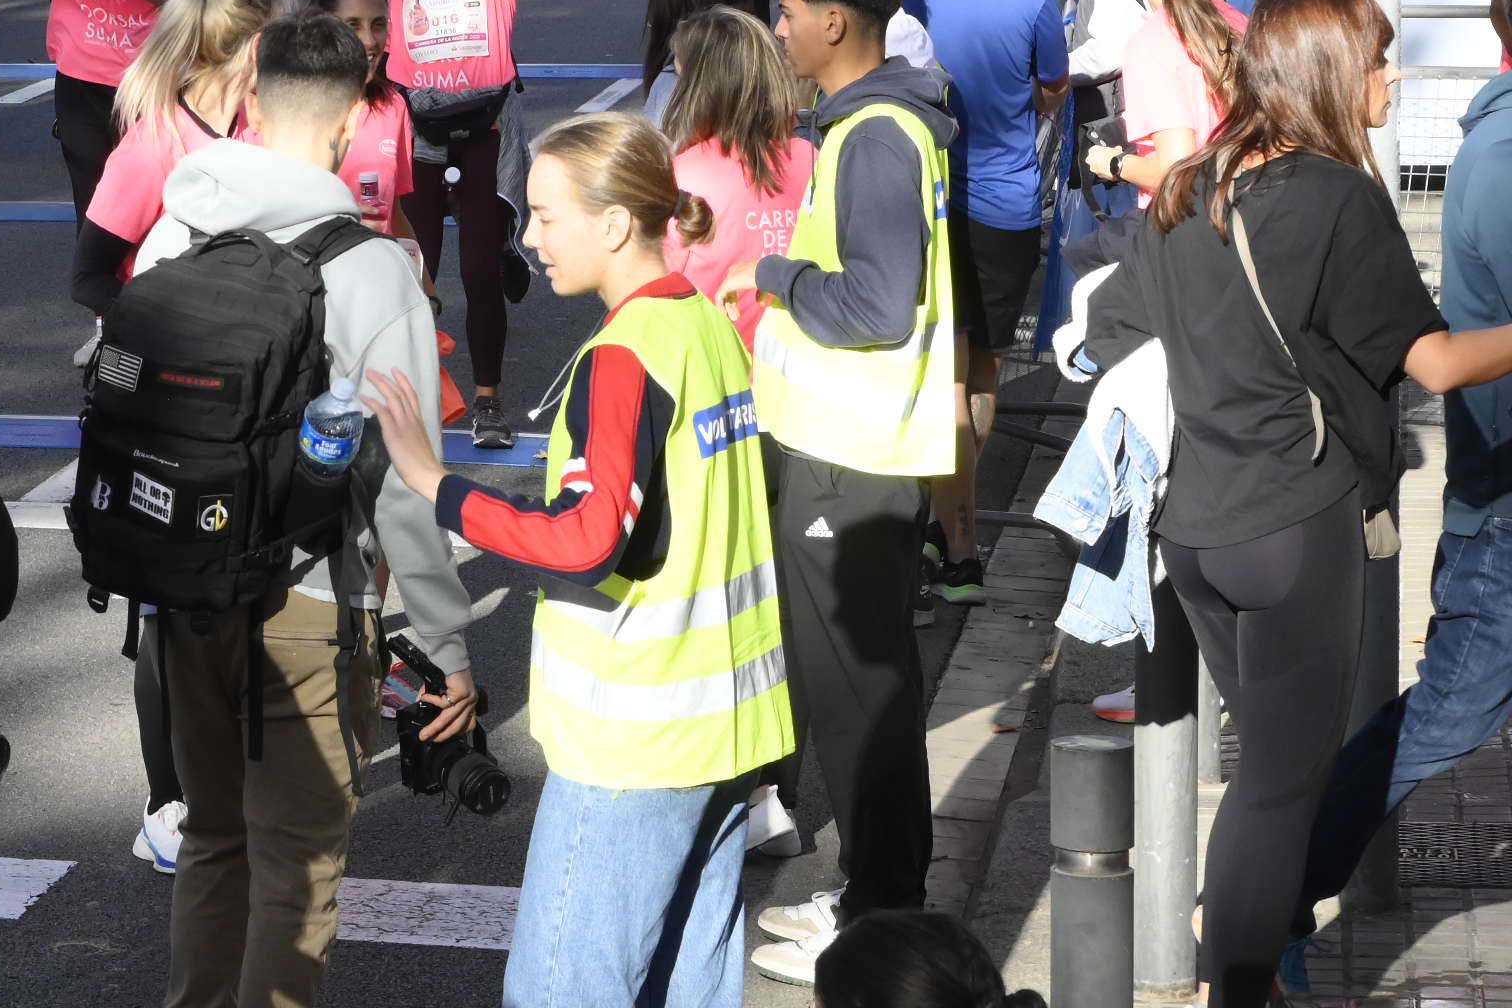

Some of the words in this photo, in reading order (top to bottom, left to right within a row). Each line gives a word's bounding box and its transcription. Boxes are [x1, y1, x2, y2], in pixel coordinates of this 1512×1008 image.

[412, 69, 469, 90] SUMA
[745, 210, 796, 231] CARR
[135, 475, 147, 494] ALL
[149, 485, 162, 501] OR
[131, 492, 170, 520] NOTHING
[805, 529, 833, 538] adidas
